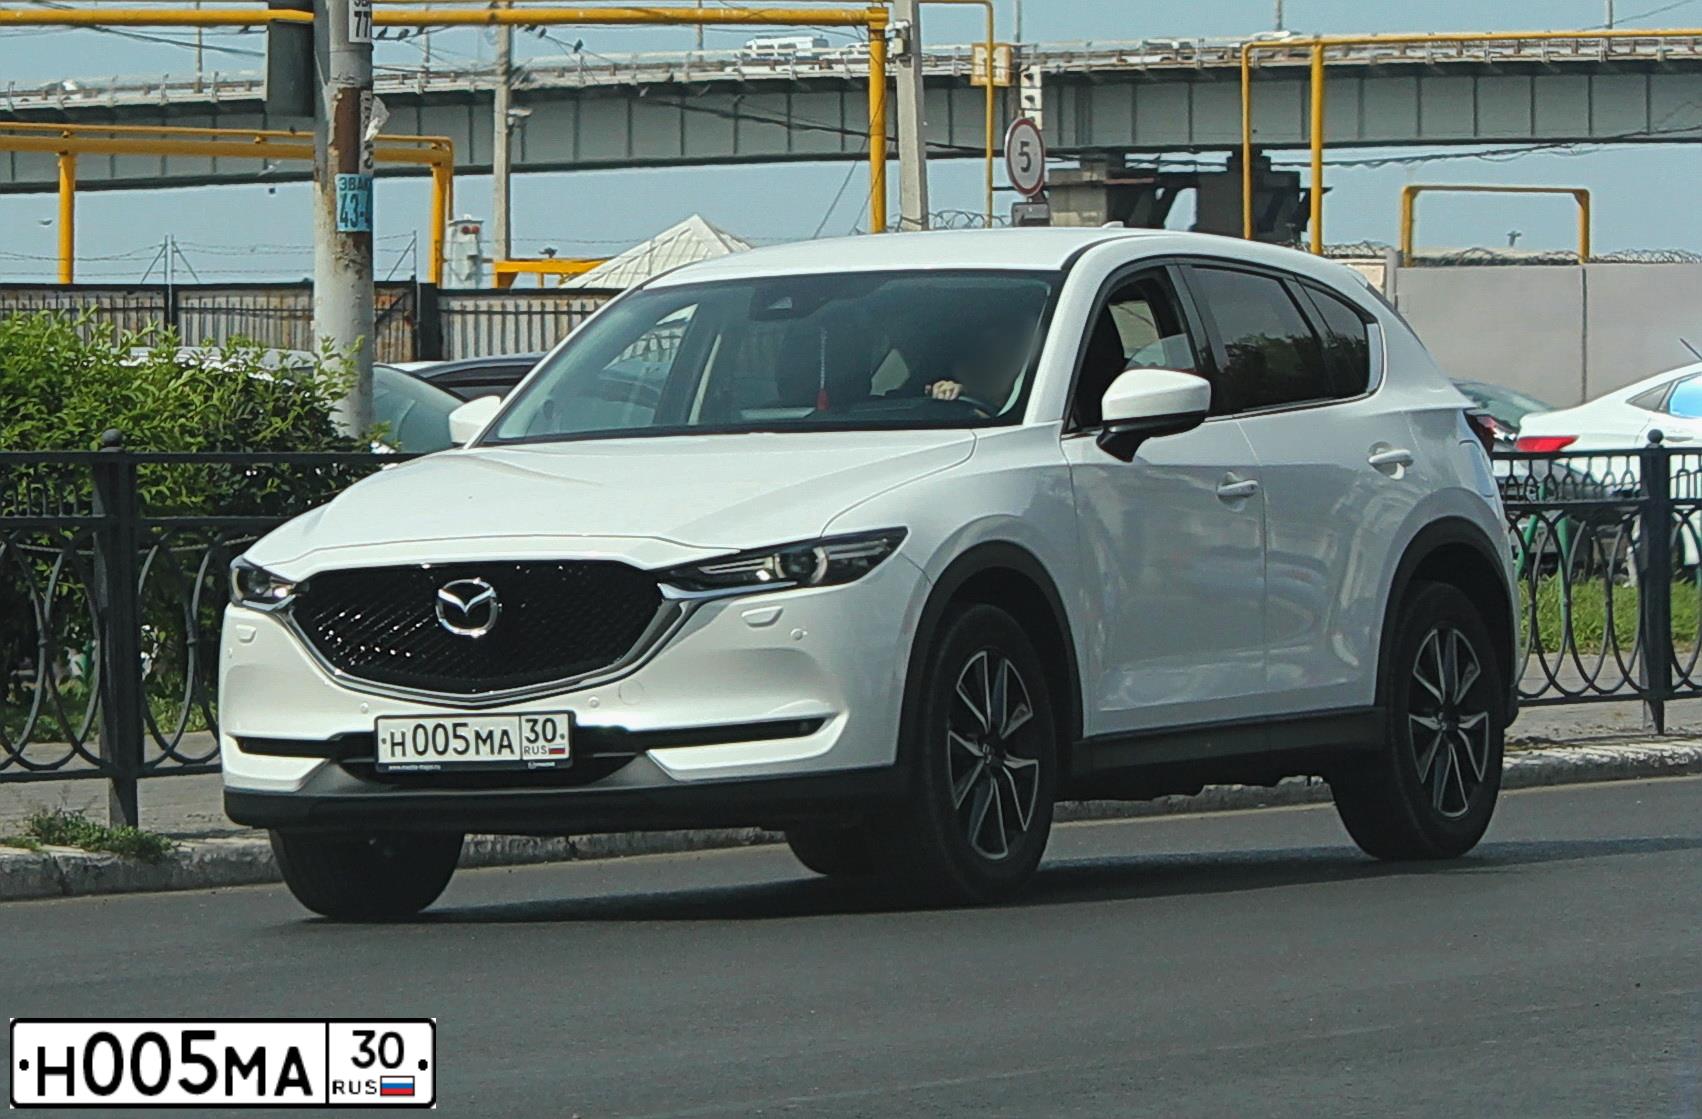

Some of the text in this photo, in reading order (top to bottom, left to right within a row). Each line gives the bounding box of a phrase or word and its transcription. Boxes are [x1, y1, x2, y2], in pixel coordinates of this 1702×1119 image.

[1019, 141, 1032, 173] 5
[389, 722, 515, 757] Н005МА
[524, 717, 557, 744] 30
[524, 745, 548, 755] RUS
